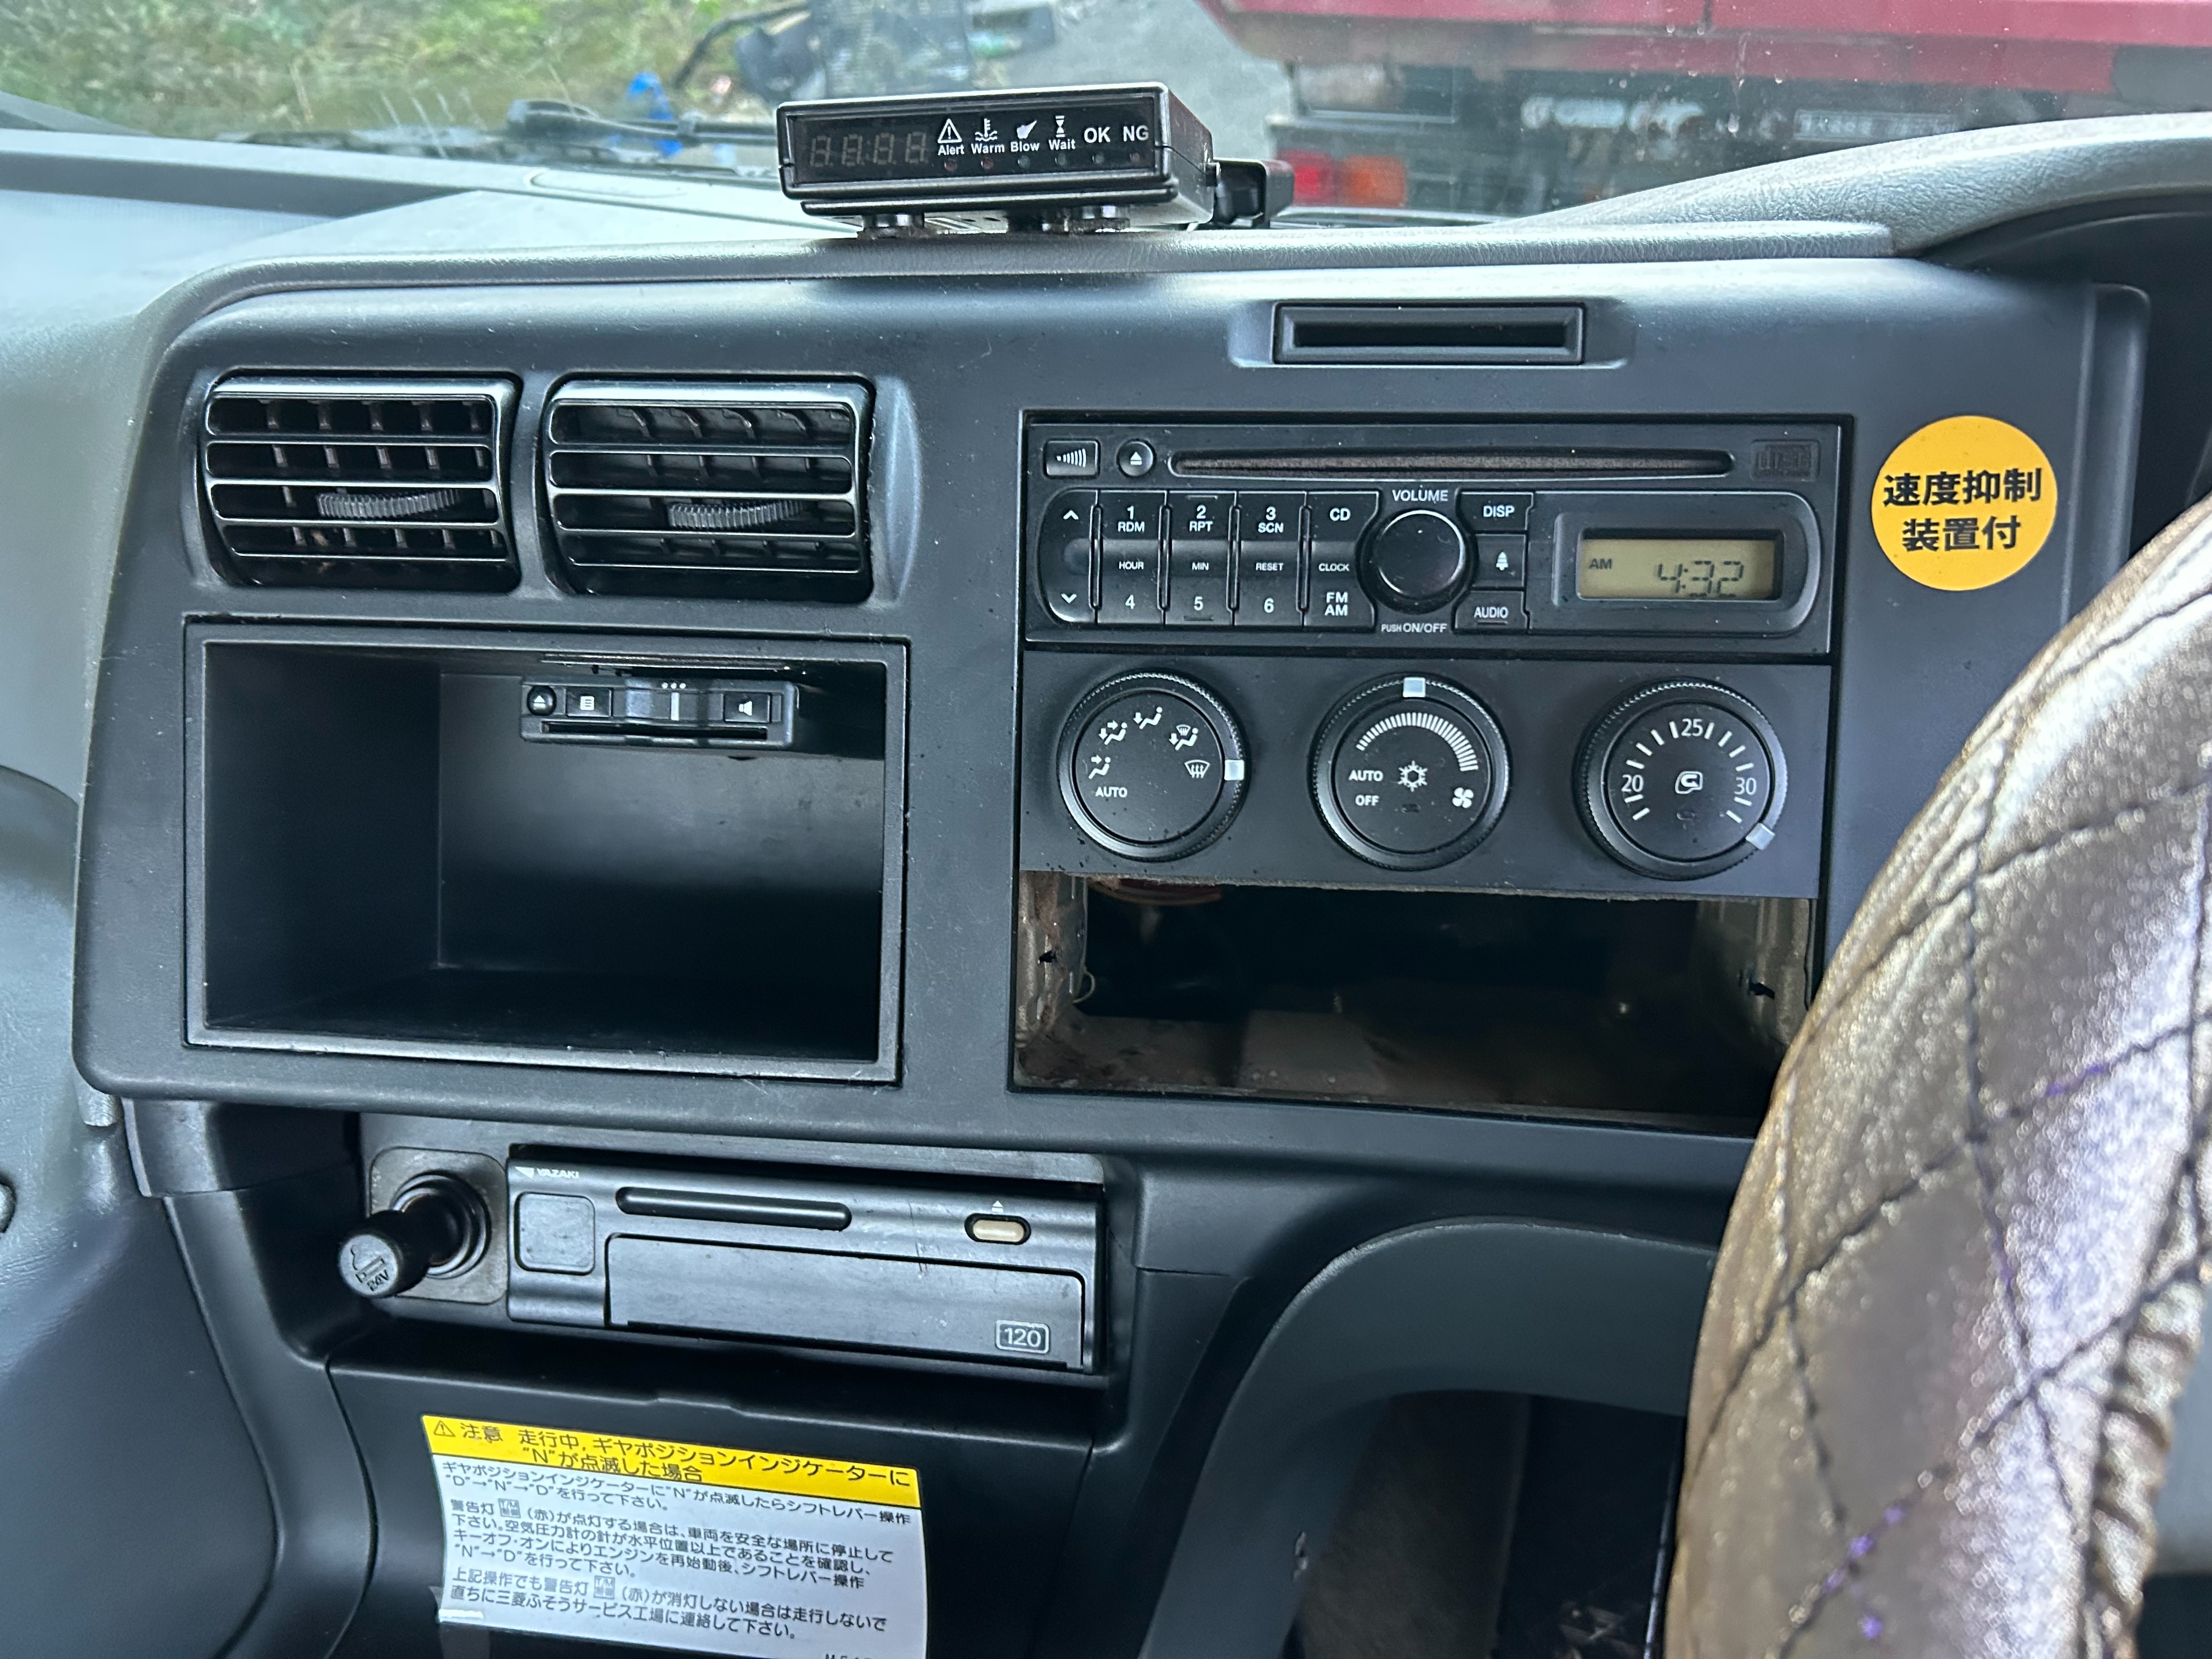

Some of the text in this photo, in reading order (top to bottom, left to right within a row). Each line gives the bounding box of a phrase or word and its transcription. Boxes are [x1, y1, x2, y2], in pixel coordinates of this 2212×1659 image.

[1084, 127, 1110, 143] OK
[1123, 125, 1149, 141] NG
[971, 143, 1005, 154] Warm
[1010, 141, 1040, 151] Blow
[1049, 139, 1075, 150] Wait
[938, 145, 964, 156] Alert
[1883, 467, 2041, 507] 速度抑制
[1392, 490, 1448, 501] VOLUME
[1127, 507, 1134, 518] 1
[1197, 506, 1206, 519] 2
[1266, 507, 1276, 520] 3
[1329, 509, 1350, 521] CD
[1483, 505, 1515, 517] DISP
[1118, 522, 1144, 532] RDM
[1189, 522, 1212, 532] RPT
[1258, 523, 1283, 533] SCN
[1902, 515, 2021, 552] 装置付
[1119, 561, 1144, 570] HOUR
[1192, 562, 1209, 571] MIN
[1256, 563, 1283, 571] RESET
[1319, 563, 1349, 572] CLOCK
[1589, 558, 1744, 598] AM 4:32
[1125, 595, 1135, 608] 4
[1194, 596, 1203, 610] 5
[1326, 592, 1348, 603] FM
[1264, 599, 1273, 612] 6
[1325, 605, 1348, 616] AM
[1474, 606, 1508, 618] AUDIO
[1381, 623, 1447, 633] PUSH ON/OFF
[1681, 719, 1703, 736] 25
[1348, 770, 1383, 781] AUTO
[1622, 775, 1644, 792] 20
[1735, 778, 1757, 795] 30
[1096, 787, 1127, 798] AUTO
[1356, 795, 1379, 806] OFF
[1005, 1327, 1041, 1346] 120
[460, 1423, 503, 1443] 注意
